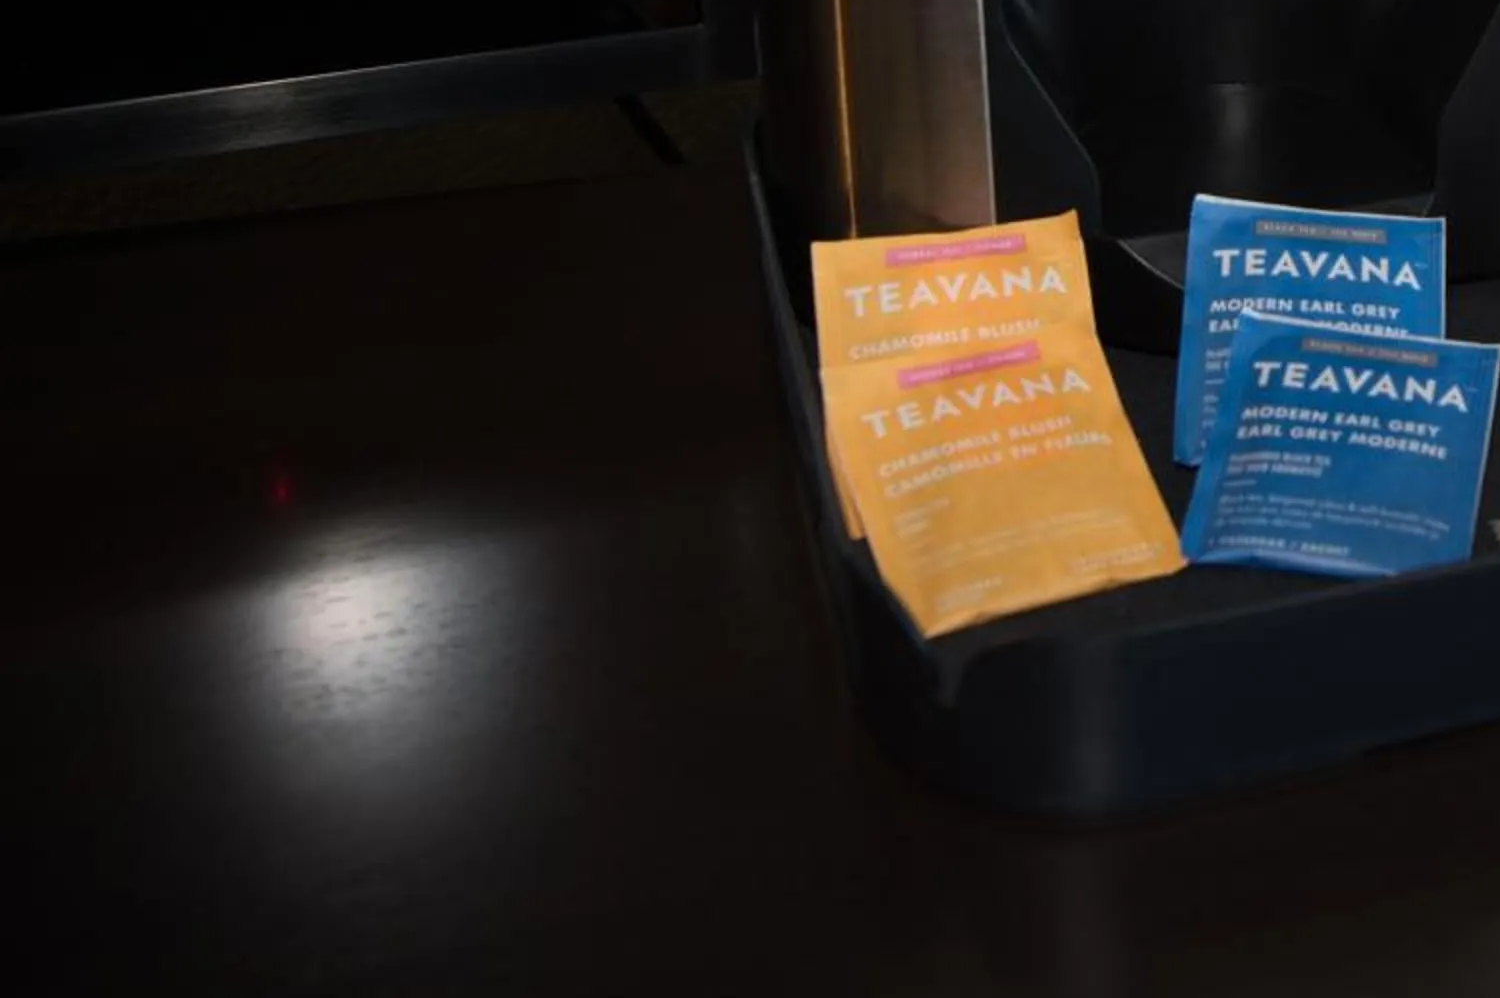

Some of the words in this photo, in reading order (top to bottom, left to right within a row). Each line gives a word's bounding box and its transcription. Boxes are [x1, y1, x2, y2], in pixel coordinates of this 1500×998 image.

[1212, 248, 1422, 291] TEAVANA
[845, 265, 1068, 318] TEAVANA
[1210, 296, 1293, 314] MODERN
[1300, 301, 1344, 315] EARL
[1352, 304, 1401, 321] GREY
[850, 326, 970, 360] CHAMOMILE
[978, 318, 1041, 340] BLUSH
[861, 367, 1092, 439] TEAVANA
[1254, 361, 1468, 413] TEAVANA
[1241, 405, 1328, 424] MODERN
[1334, 413, 1381, 430] EARL
[1388, 419, 1442, 439] GREY
[1236, 426, 1283, 440] EARL
[1289, 426, 1344, 444] GREY
[1349, 432, 1448, 461] MODERNE
